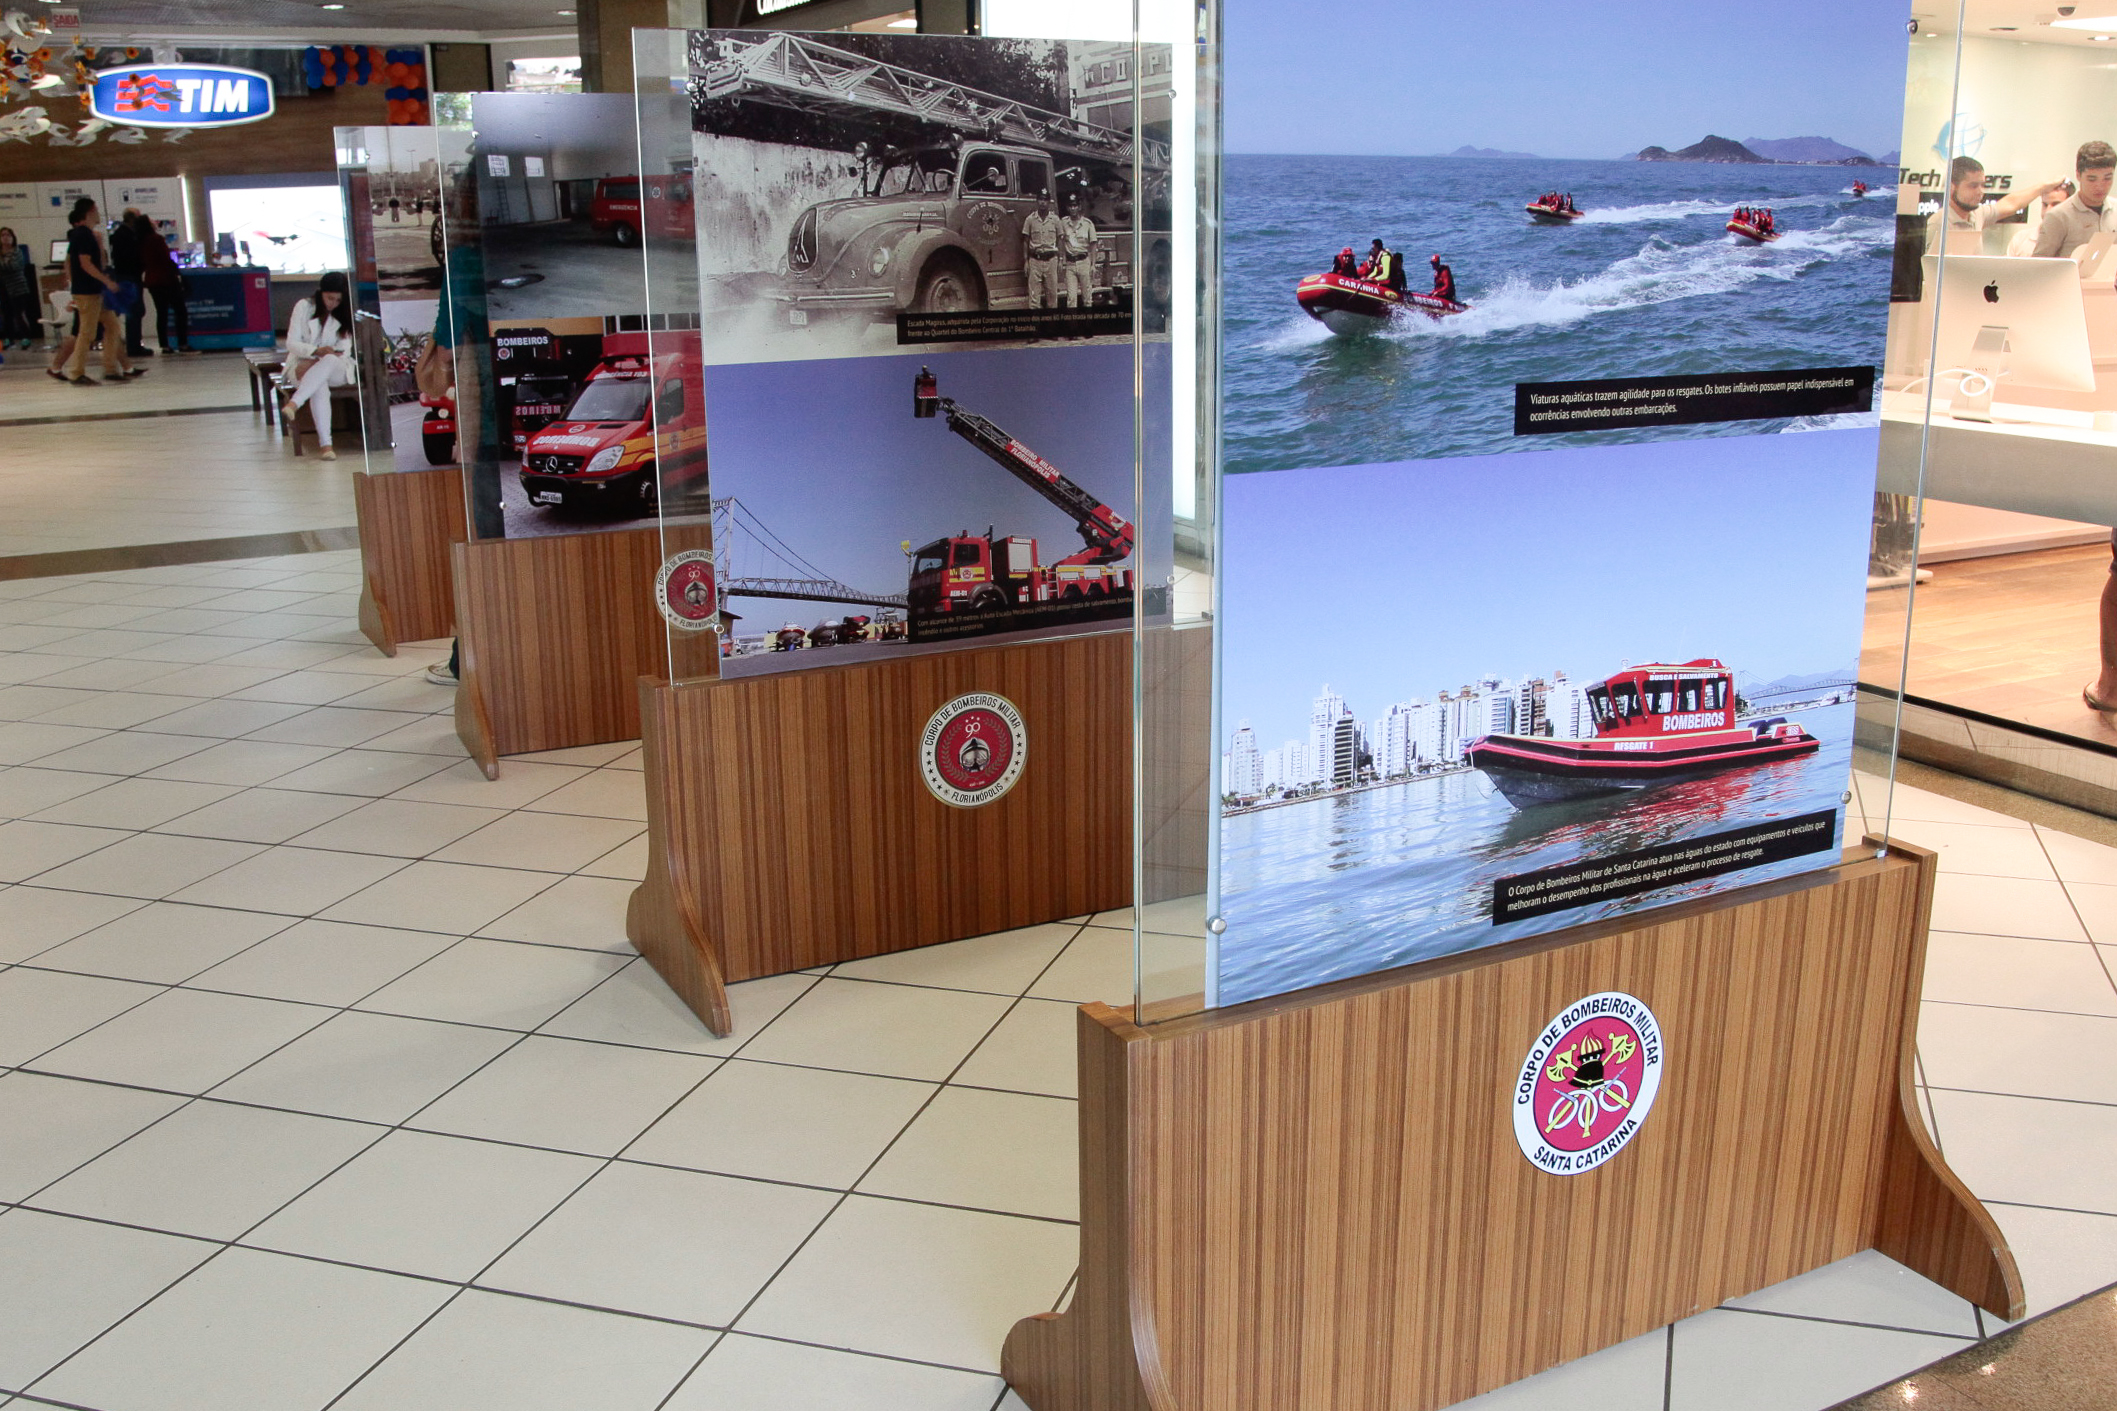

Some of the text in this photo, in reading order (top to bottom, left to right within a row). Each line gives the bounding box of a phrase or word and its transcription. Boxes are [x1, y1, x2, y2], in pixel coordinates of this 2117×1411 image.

[176, 79, 249, 113] TIM
[1899, 168, 1941, 188] Tech
[1338, 278, 1380, 295] CARANHA
[497, 336, 549, 347] BOMBEIROS
[930, 328, 949, 337] Quartel
[1530, 378, 1854, 405] Viaturas aquáticas trazem agilidade para os resgates. Os botes infláveis possuem papel indispensável em
[1530, 402, 1678, 422] ocorrências envolvendo outras embarcações.
[1010, 439, 1060, 478] BOMBEIRO MILITAR
[1678, 672, 1719, 680] SALVAMENTO
[924, 695, 1022, 747] CORPO DE BOMBEIROS MILITAR
[965, 721, 981, 739] 90
[1662, 711, 1725, 731] BOMBEIROS
[951, 782, 1004, 804] FLORIANÓPOLIS
[1508, 886, 1515, 898] O
[1515, 884, 1535, 896] Corpo
[1536, 881, 1546, 892] de
[1546, 874, 1581, 889] Bombeiros
[1581, 868, 1603, 881] Militar
[1603, 866, 1613, 876] de
[1613, 862, 1631, 874] Santa
[1632, 856, 1658, 870] Catarina
[1659, 854, 1673, 864] atua
[1673, 851, 1685, 860] nas
[1685, 847, 1703, 860] águas
[1703, 844, 1712, 854] do
[1712, 839, 1733, 852] estado
[1733, 838, 1746, 847] com
[1746, 829, 1786, 846] equipamentos
[1791, 822, 1814, 835] veículos
[1814, 821, 1826, 832] que
[1507, 847, 1765, 912] melhoram o desempenho dos profissionais na água e aceleram o processo de resgate.
[1517, 997, 1659, 1105] CORPO DE BOMBEIROS MILITAR
[1533, 1118, 1638, 1171] SANTA CATARINA
